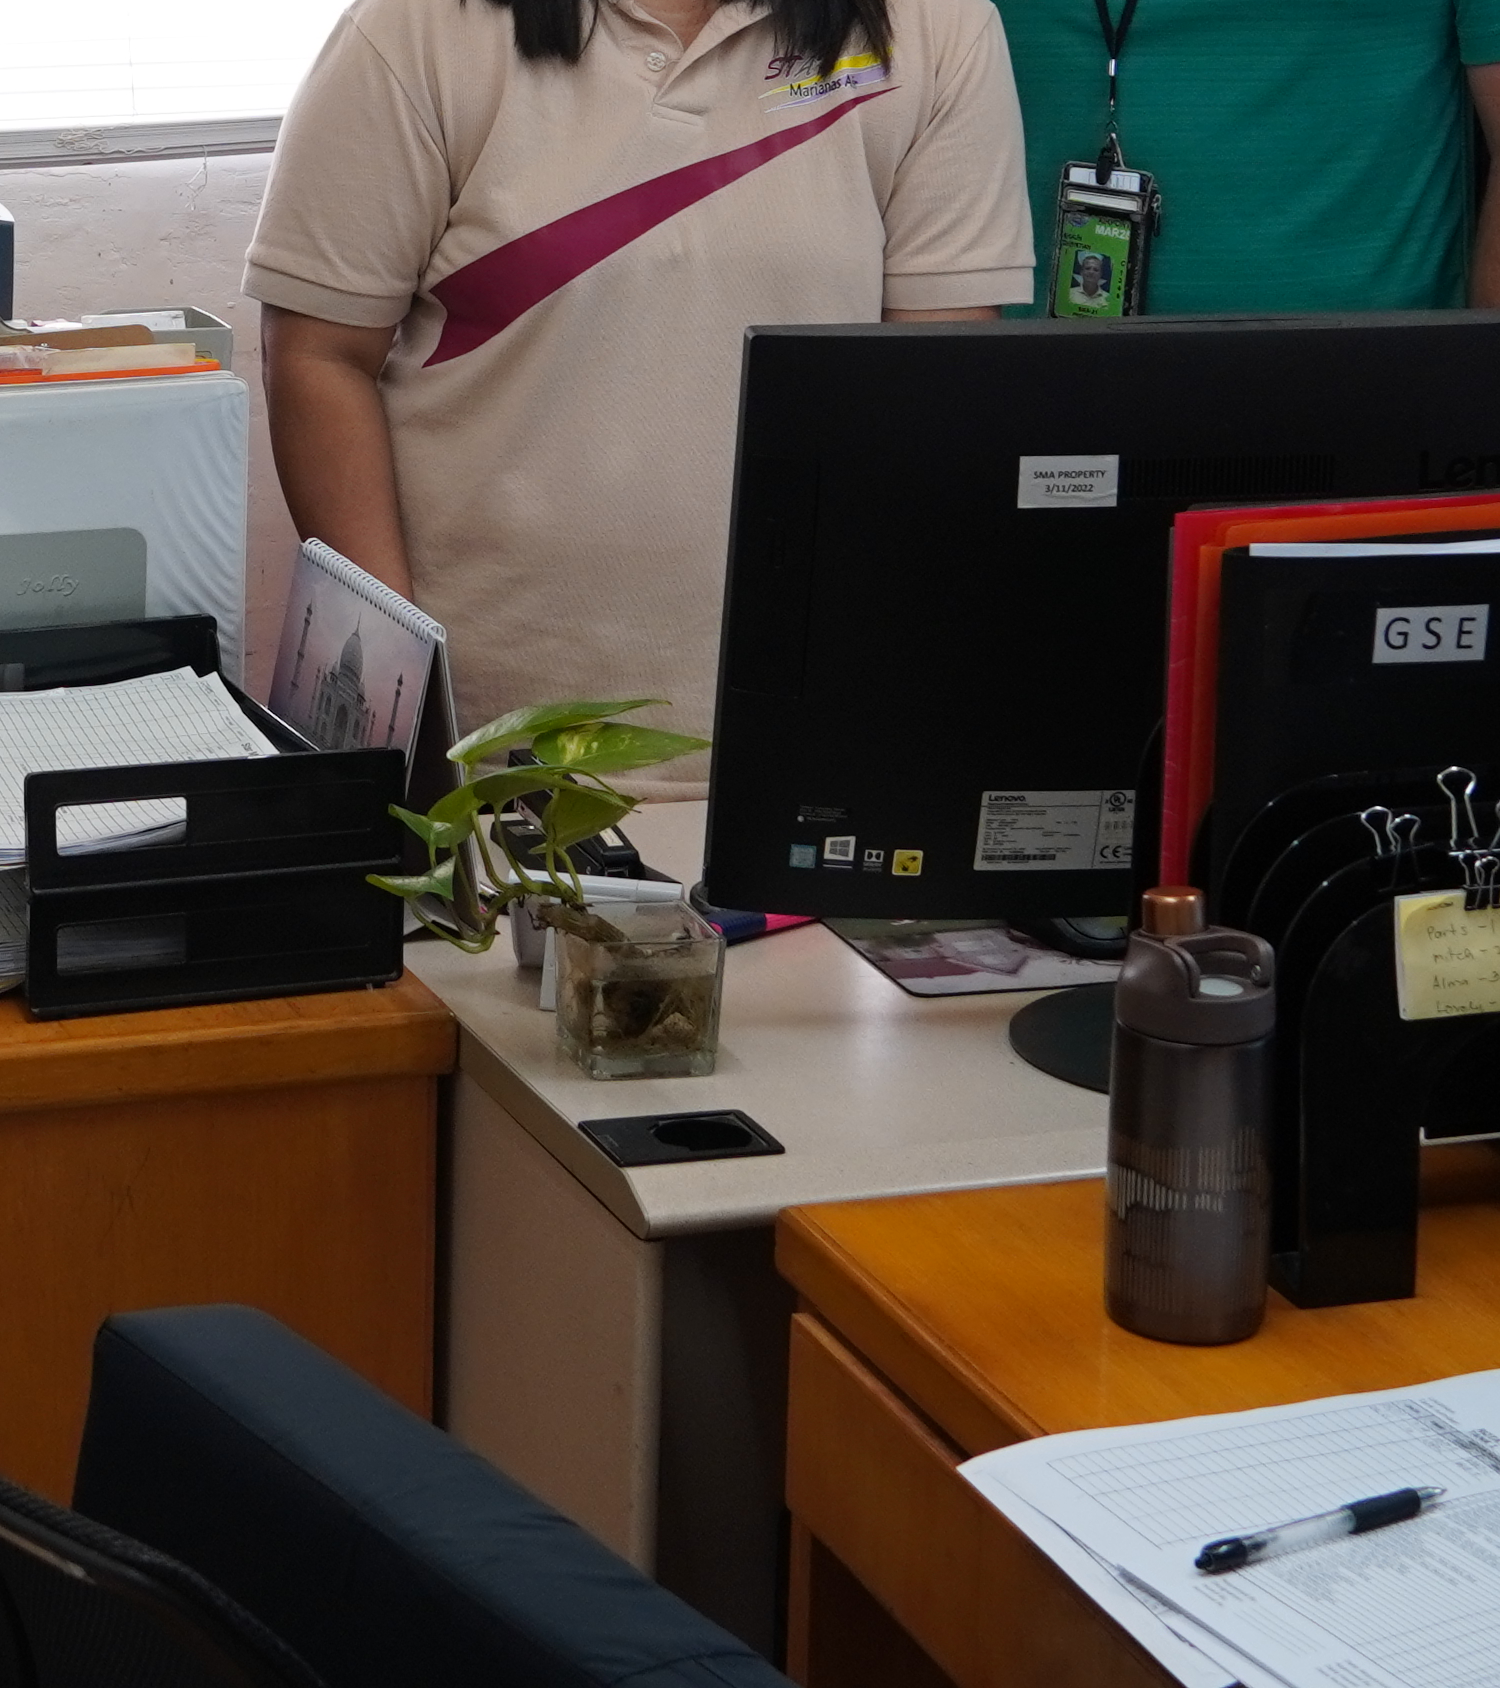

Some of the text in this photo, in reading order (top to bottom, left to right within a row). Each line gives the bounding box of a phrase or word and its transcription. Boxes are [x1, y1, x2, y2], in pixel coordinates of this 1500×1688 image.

[790, 76, 842, 98] Marianas
[1033, 469, 1106, 480] SMA PROPERTY
[1044, 483, 1094, 495] 3/11/2022
[988, 793, 1026, 803] Lenovo
